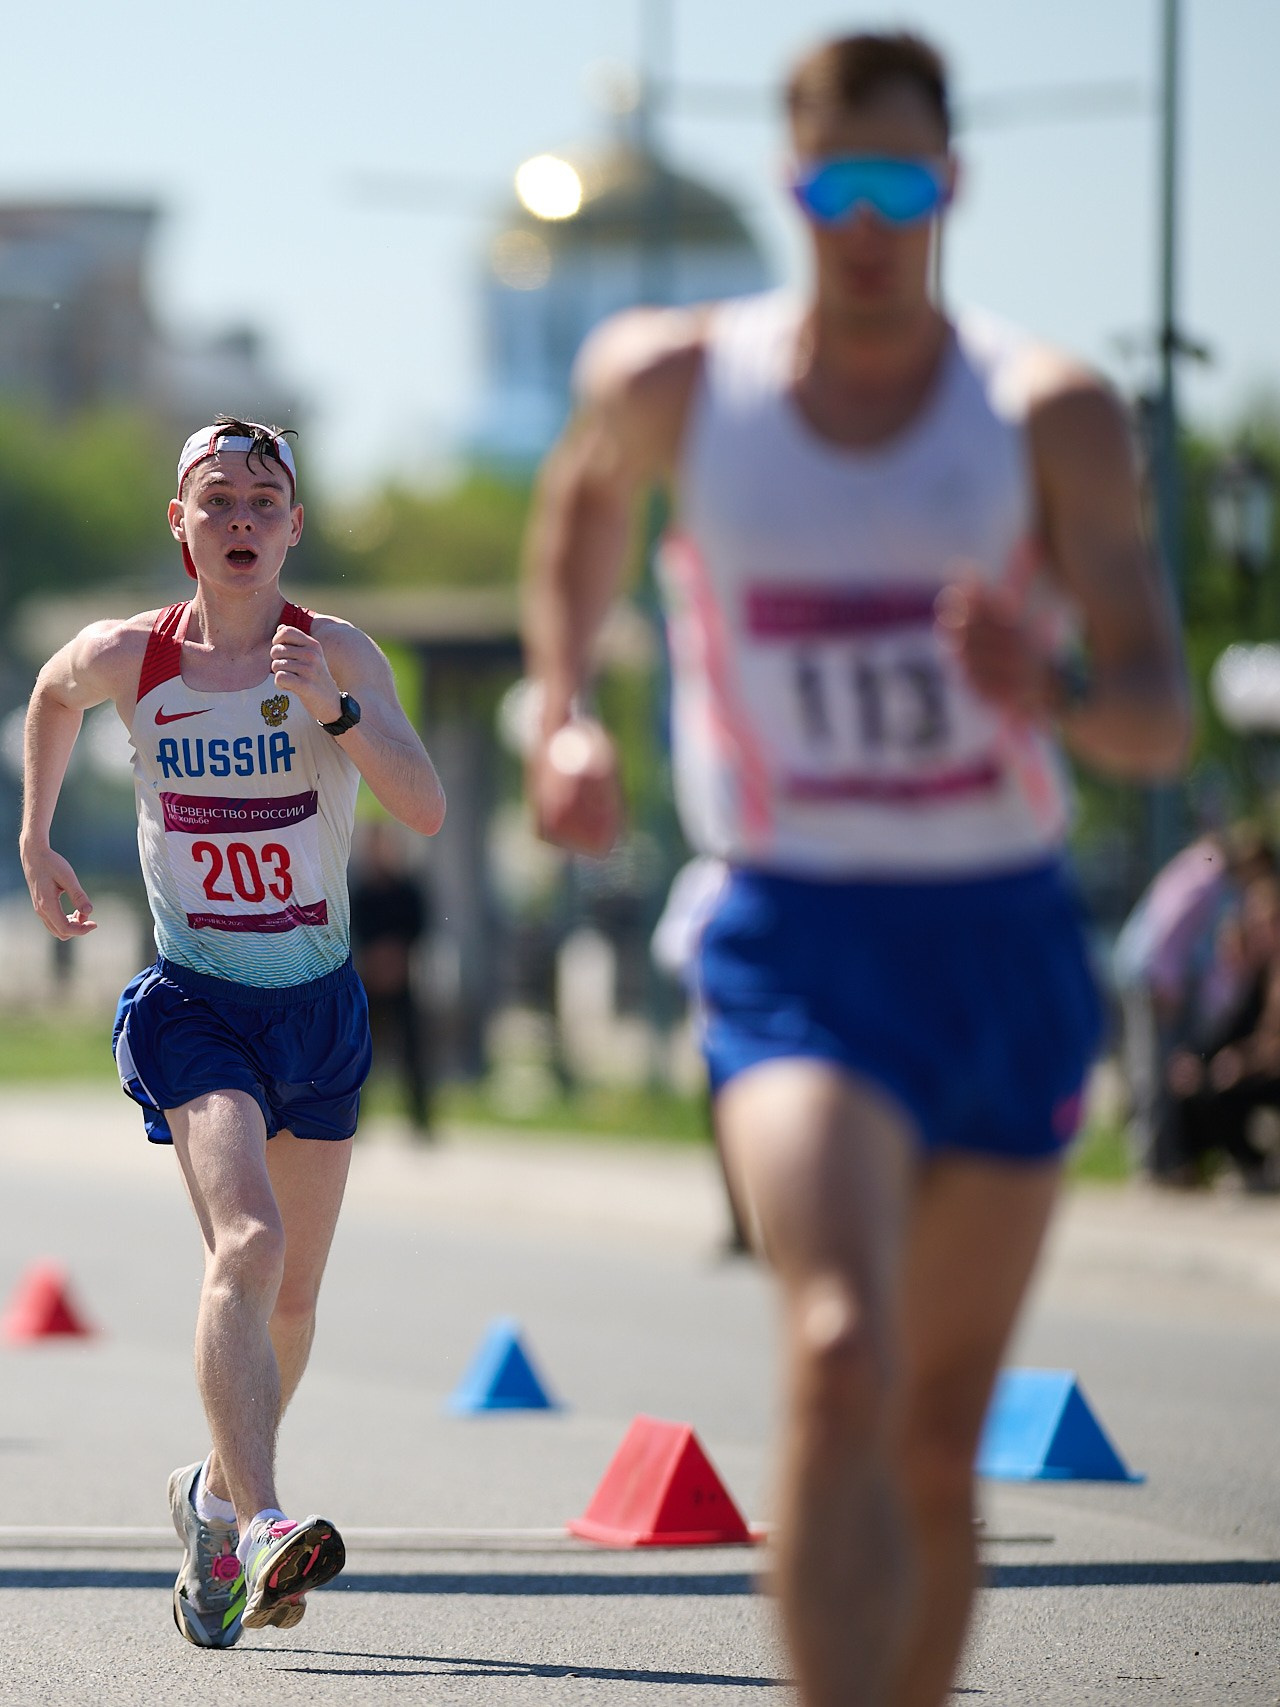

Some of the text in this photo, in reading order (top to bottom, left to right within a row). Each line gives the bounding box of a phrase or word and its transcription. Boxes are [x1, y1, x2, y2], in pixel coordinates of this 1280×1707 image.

[792, 650, 952, 758] 113
[156, 731, 296, 778] RUSSIA
[165, 803, 305, 820] ПЕРВЕНСТВО РОССИИ
[178, 815, 210, 825] ходьбе
[191, 841, 293, 903] 203
